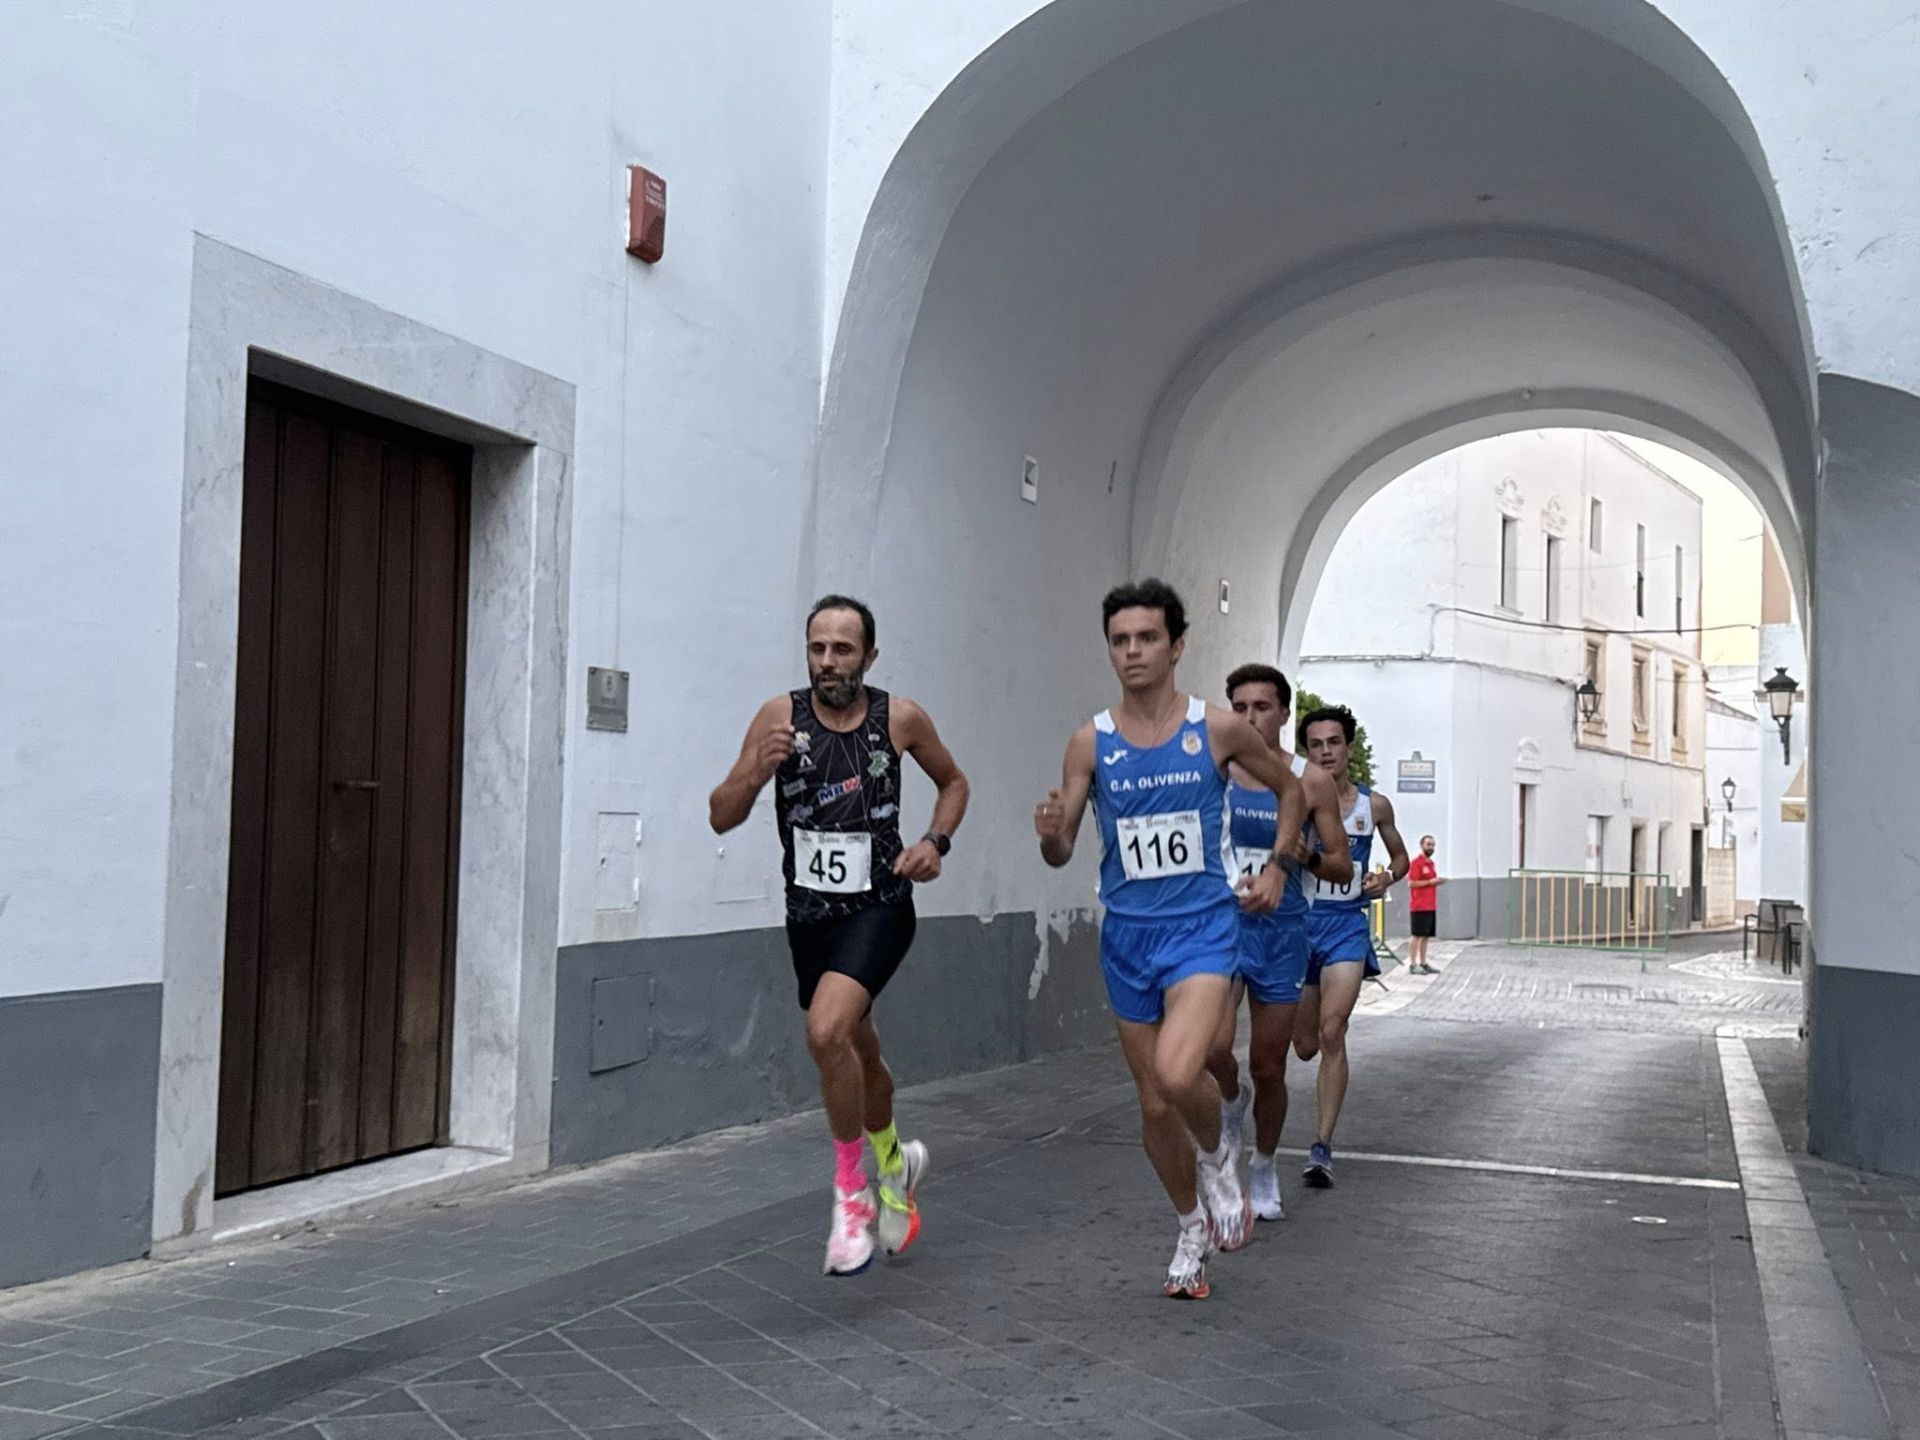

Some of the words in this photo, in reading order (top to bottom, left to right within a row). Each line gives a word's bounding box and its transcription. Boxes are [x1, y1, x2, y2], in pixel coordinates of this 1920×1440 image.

[1138, 770, 1201, 790] OLIVENZA
[1234, 806, 1279, 821] OLIVENZ
[1128, 830, 1188, 870] 116
[809, 848, 847, 884] 45
